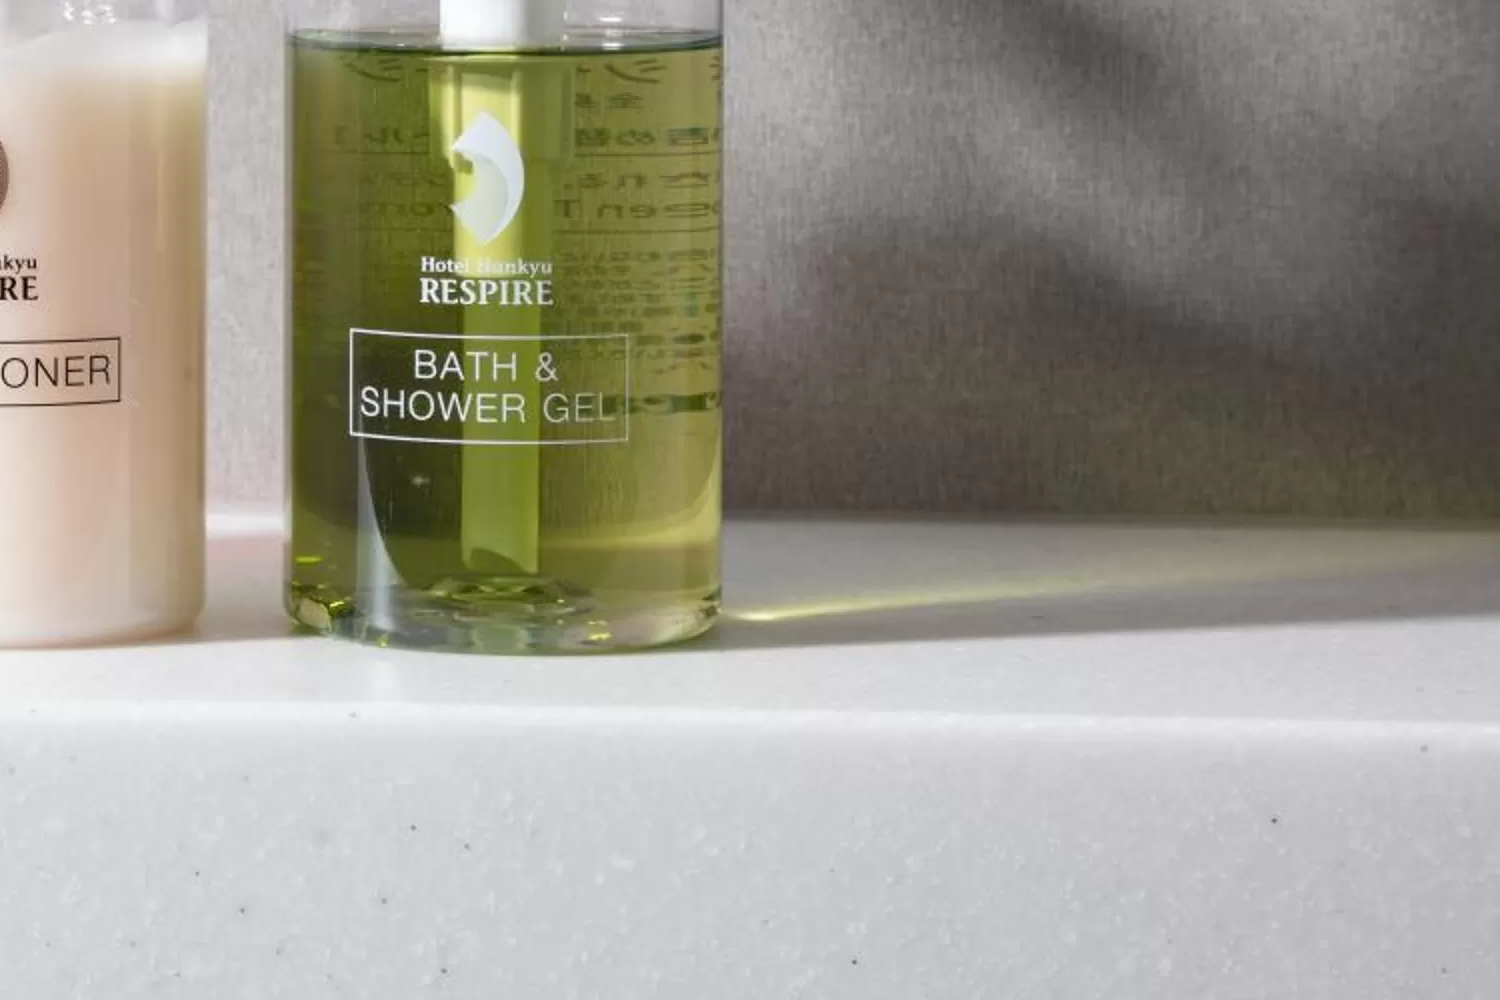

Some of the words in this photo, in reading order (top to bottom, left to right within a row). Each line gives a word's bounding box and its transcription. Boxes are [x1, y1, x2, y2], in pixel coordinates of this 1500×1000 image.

[420, 255, 469, 274] Hotel
[476, 257, 553, 278] Hankyu
[419, 277, 554, 305] RESPIRE
[414, 350, 518, 382] BATH
[535, 352, 559, 382] &
[360, 386, 527, 425] SHOWER
[543, 393, 617, 425] GEL
